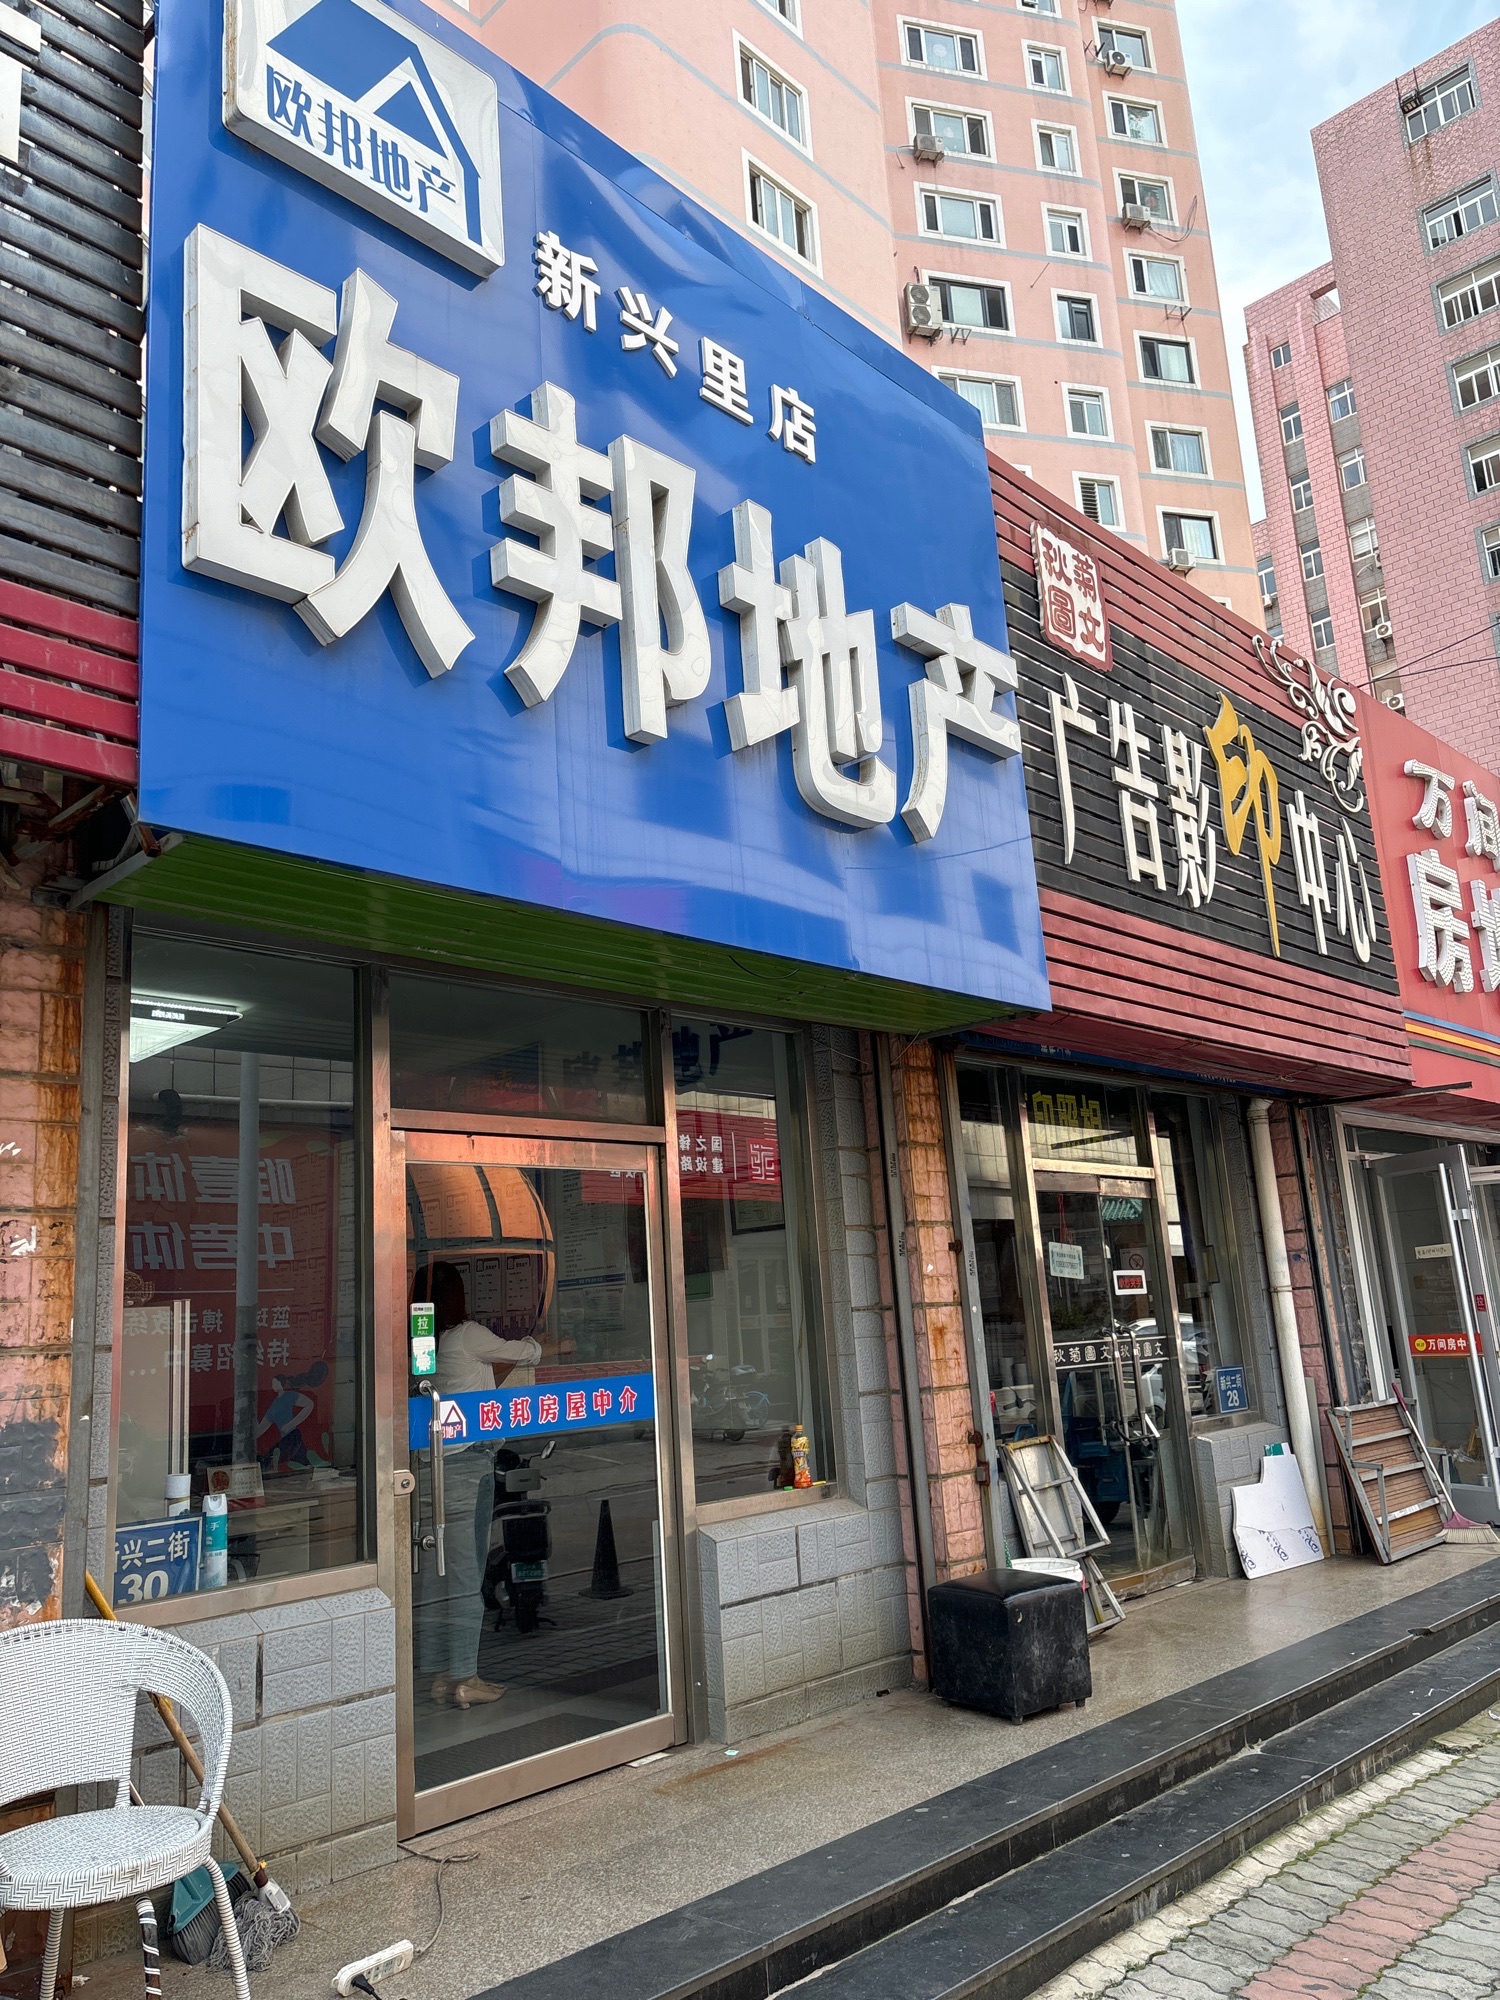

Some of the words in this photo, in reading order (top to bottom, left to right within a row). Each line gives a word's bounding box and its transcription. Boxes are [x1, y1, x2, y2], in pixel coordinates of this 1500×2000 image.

[265, 64, 457, 213] 欧邦地产
[535, 230, 817, 464] 新兴里店
[181, 222, 1020, 843] 欧邦地产
[1047, 672, 1378, 964] 广告影印中心
[417, 1316, 429, 1330] 拉
[1427, 1337, 1474, 1351] 万间房中
[478, 1385, 639, 1432] 欧邦房屋中介
[1226, 1389, 1240, 1407] 28
[115, 1530, 191, 1572] 兴二街
[118, 1569, 170, 1604] 30
